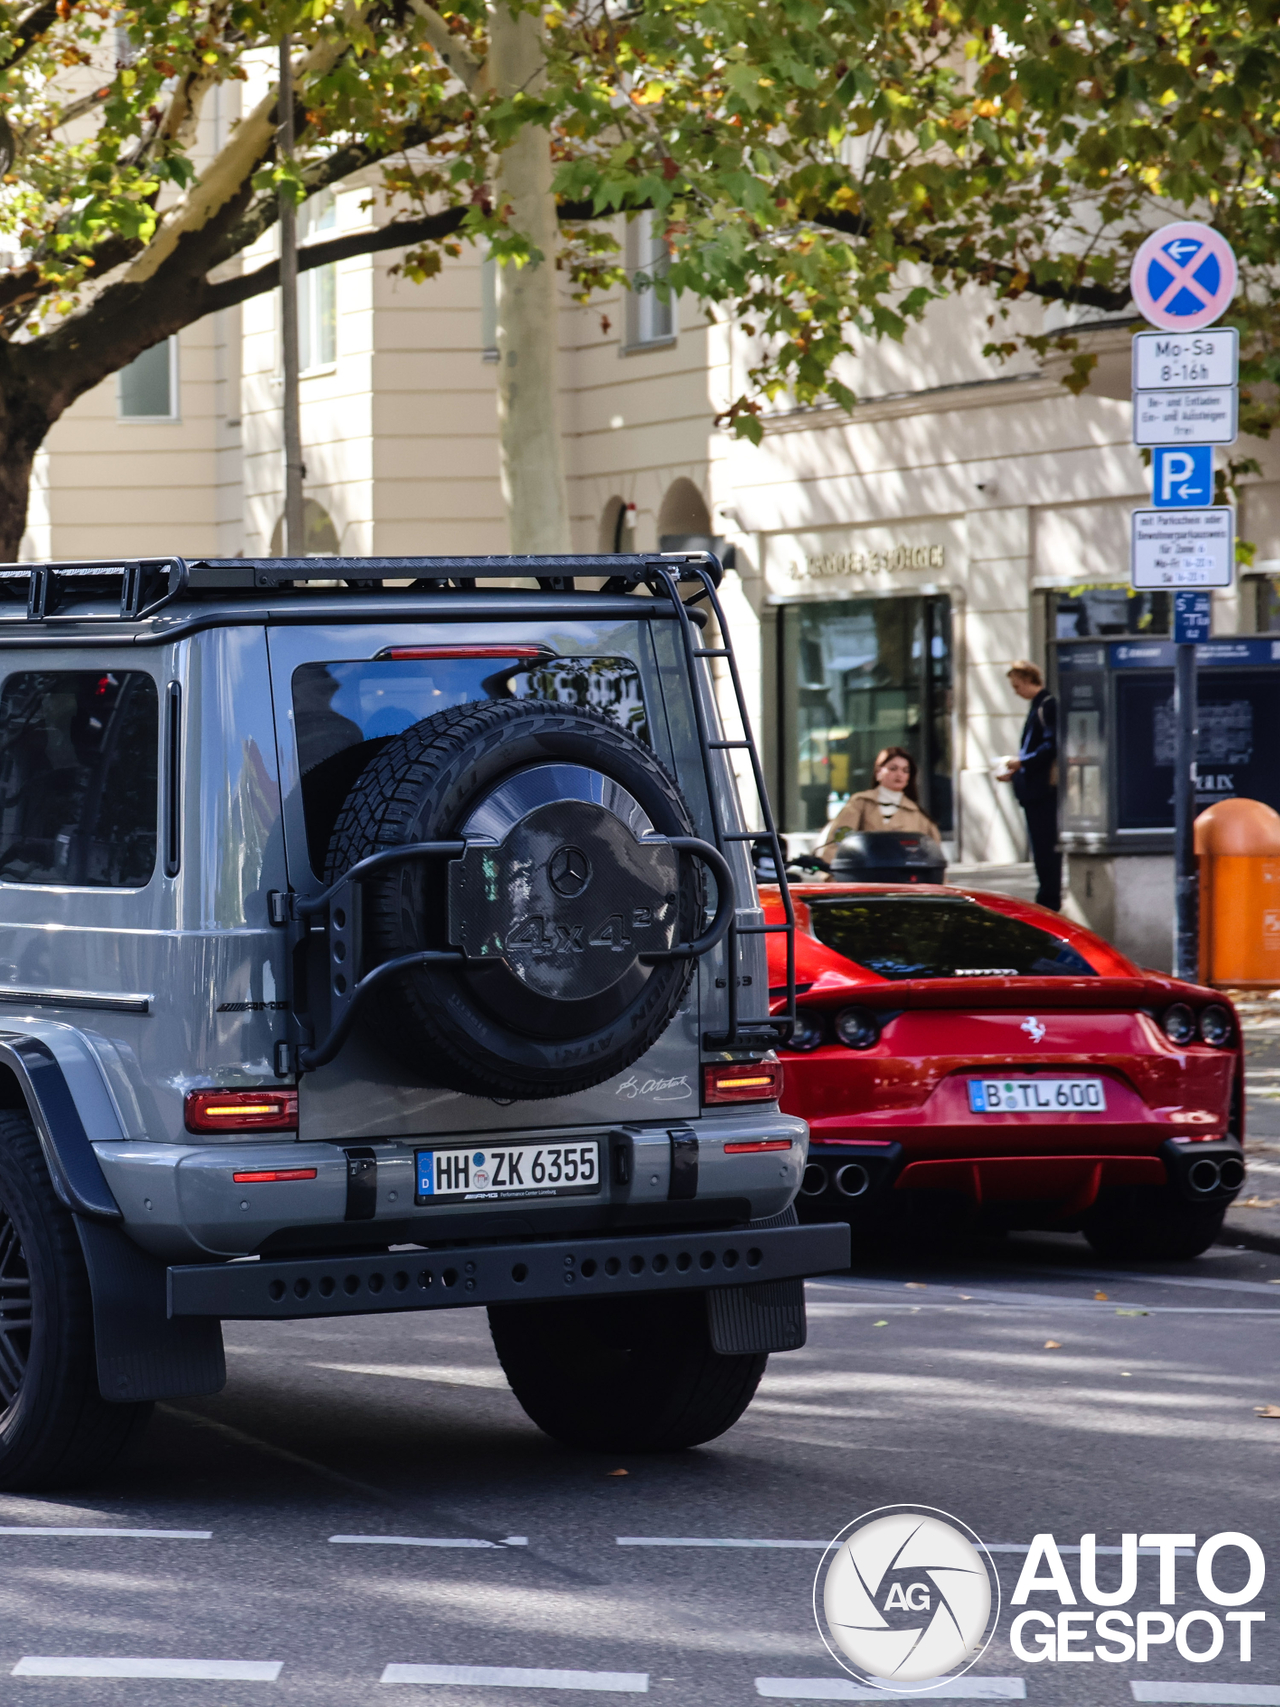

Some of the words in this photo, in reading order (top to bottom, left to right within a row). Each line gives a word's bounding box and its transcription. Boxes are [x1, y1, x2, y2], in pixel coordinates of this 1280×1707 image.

[1155, 339, 1214, 358] Mo-Sa
[1161, 451, 1195, 500] P
[986, 1084, 1002, 1107] B
[1018, 1084, 1050, 1107] TL
[1055, 1083, 1100, 1107] 600
[436, 1155, 470, 1190] HH
[491, 1151, 524, 1187] ZK
[531, 1147, 595, 1183] 6355
